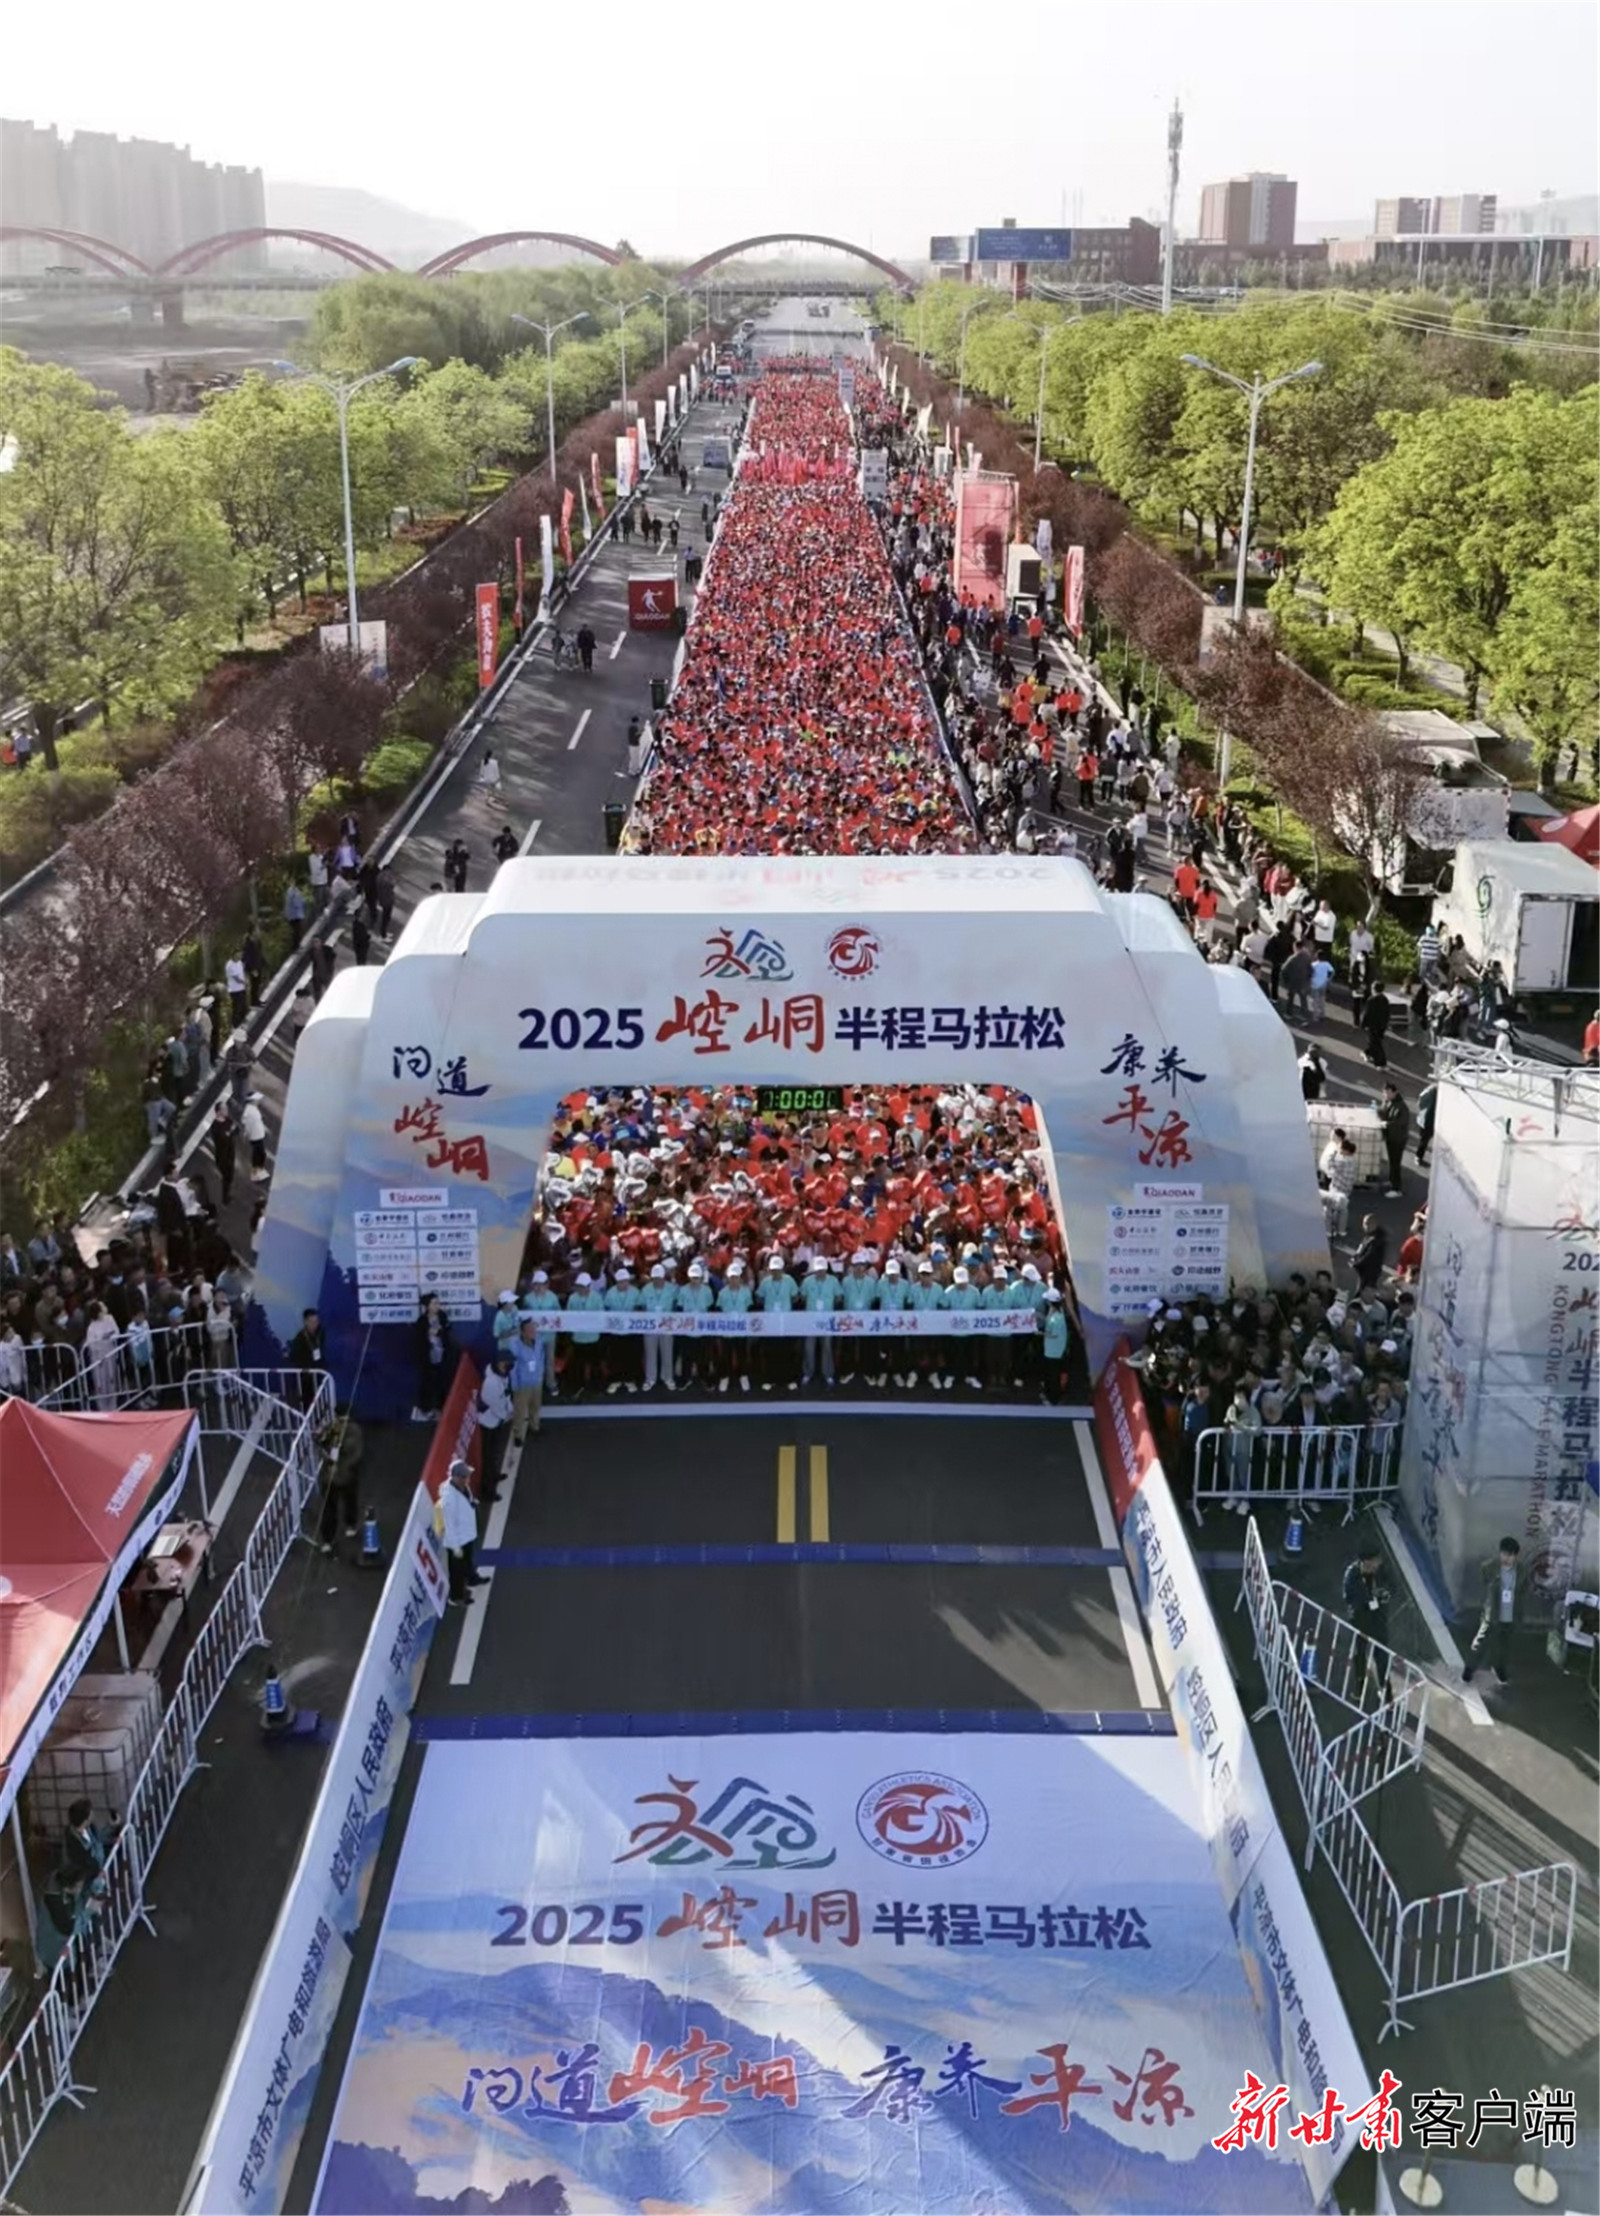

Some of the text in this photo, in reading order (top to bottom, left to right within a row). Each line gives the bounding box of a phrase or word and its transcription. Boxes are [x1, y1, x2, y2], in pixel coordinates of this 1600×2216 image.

[517, 990, 1065, 1054] 2025 崆峒 半程马拉松
[393, 1045, 493, 1096] 问道
[1100, 1033, 1207, 1098] 康养
[394, 1097, 489, 1181] 崆峒
[1102, 1084, 1193, 1169] 平凉
[628, 1320, 656, 1330] 2025
[973, 1317, 1000, 1329] 2025
[1545, 1284, 1568, 1384] KONGTONG
[1524, 1444, 1550, 1539] MARATHON
[1137, 1500, 1188, 1650] 平凉市人民政府
[330, 1694, 395, 1897] 崆峒区人民政府
[490, 1885, 1152, 1950] 2025 崆峒 半程马拉松
[237, 1916, 332, 2198] 平凉市文体广电和旅游局
[1252, 1884, 1346, 2156] 平凉市文体广电和旅局
